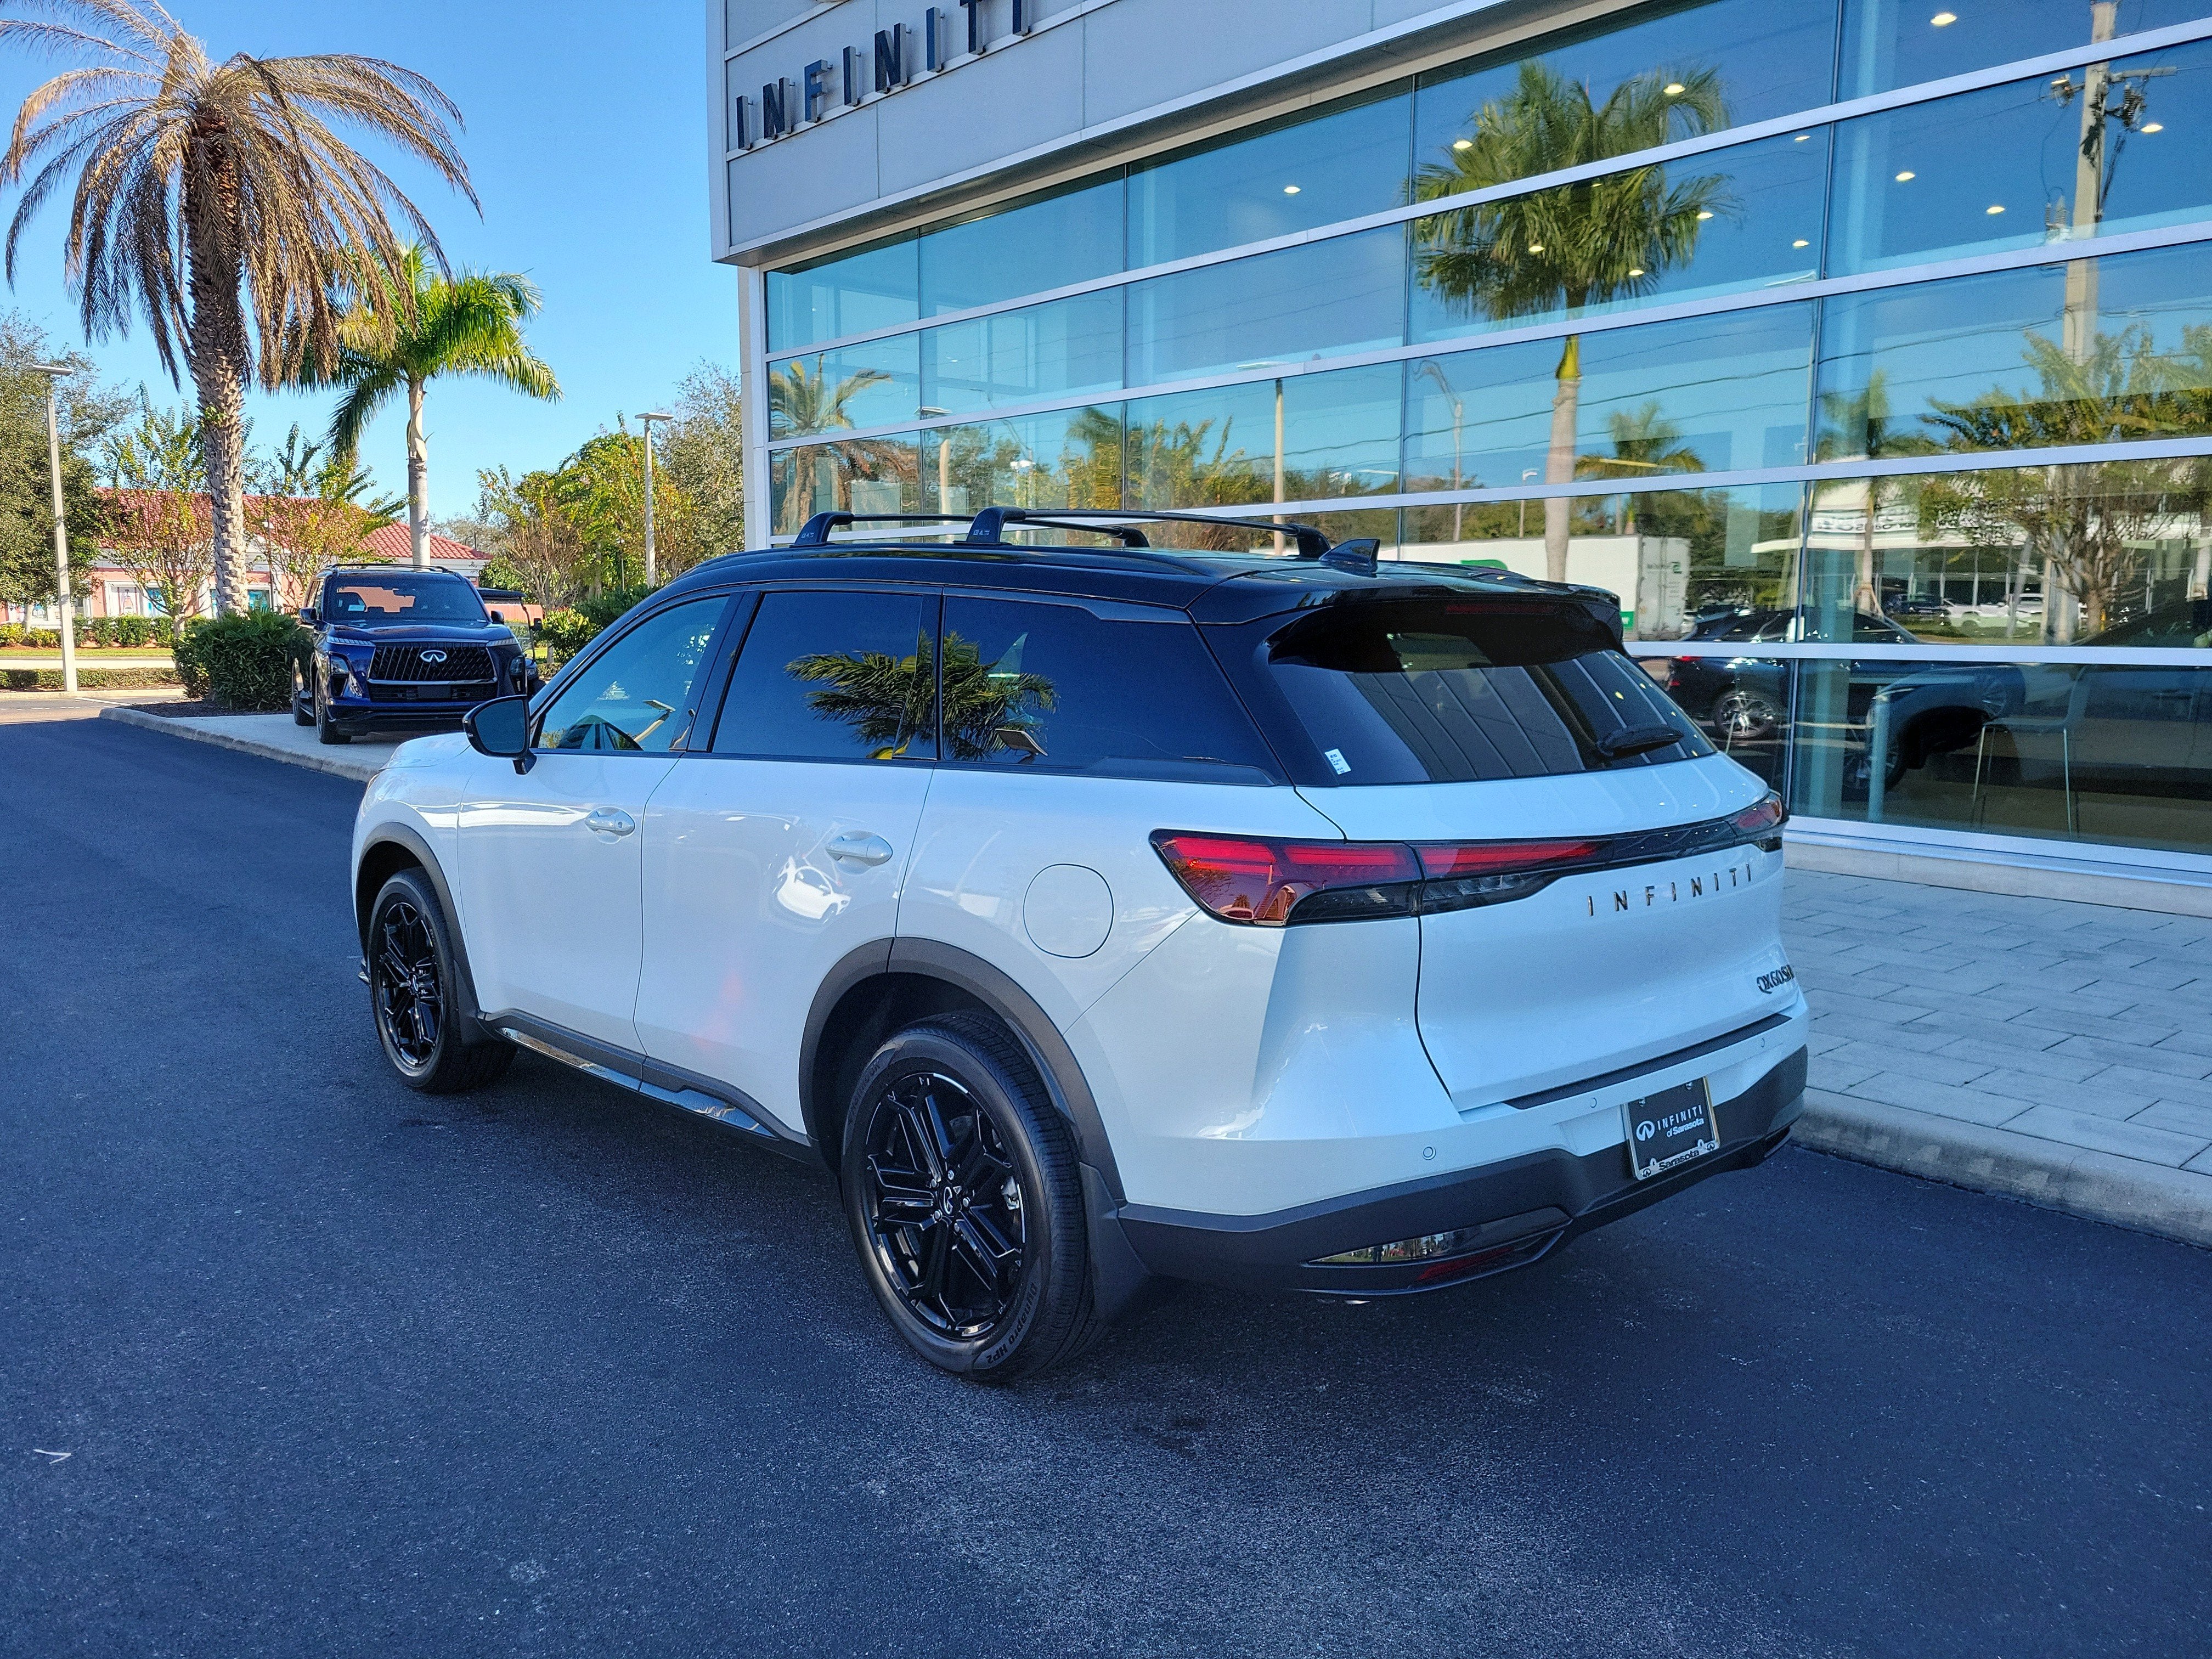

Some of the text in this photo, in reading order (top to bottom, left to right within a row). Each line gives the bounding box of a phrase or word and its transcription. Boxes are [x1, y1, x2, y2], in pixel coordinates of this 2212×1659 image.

[736, 0, 1030, 150] INFINITI
[1587, 863, 1752, 917] INFINITI
[1657, 1104, 1703, 1131] INFINITI
[1673, 1118, 1705, 1137] Sarasota
[1658, 1150, 1700, 1170] Sarasota
[986, 1282, 1038, 1364] Dynapro HP2
